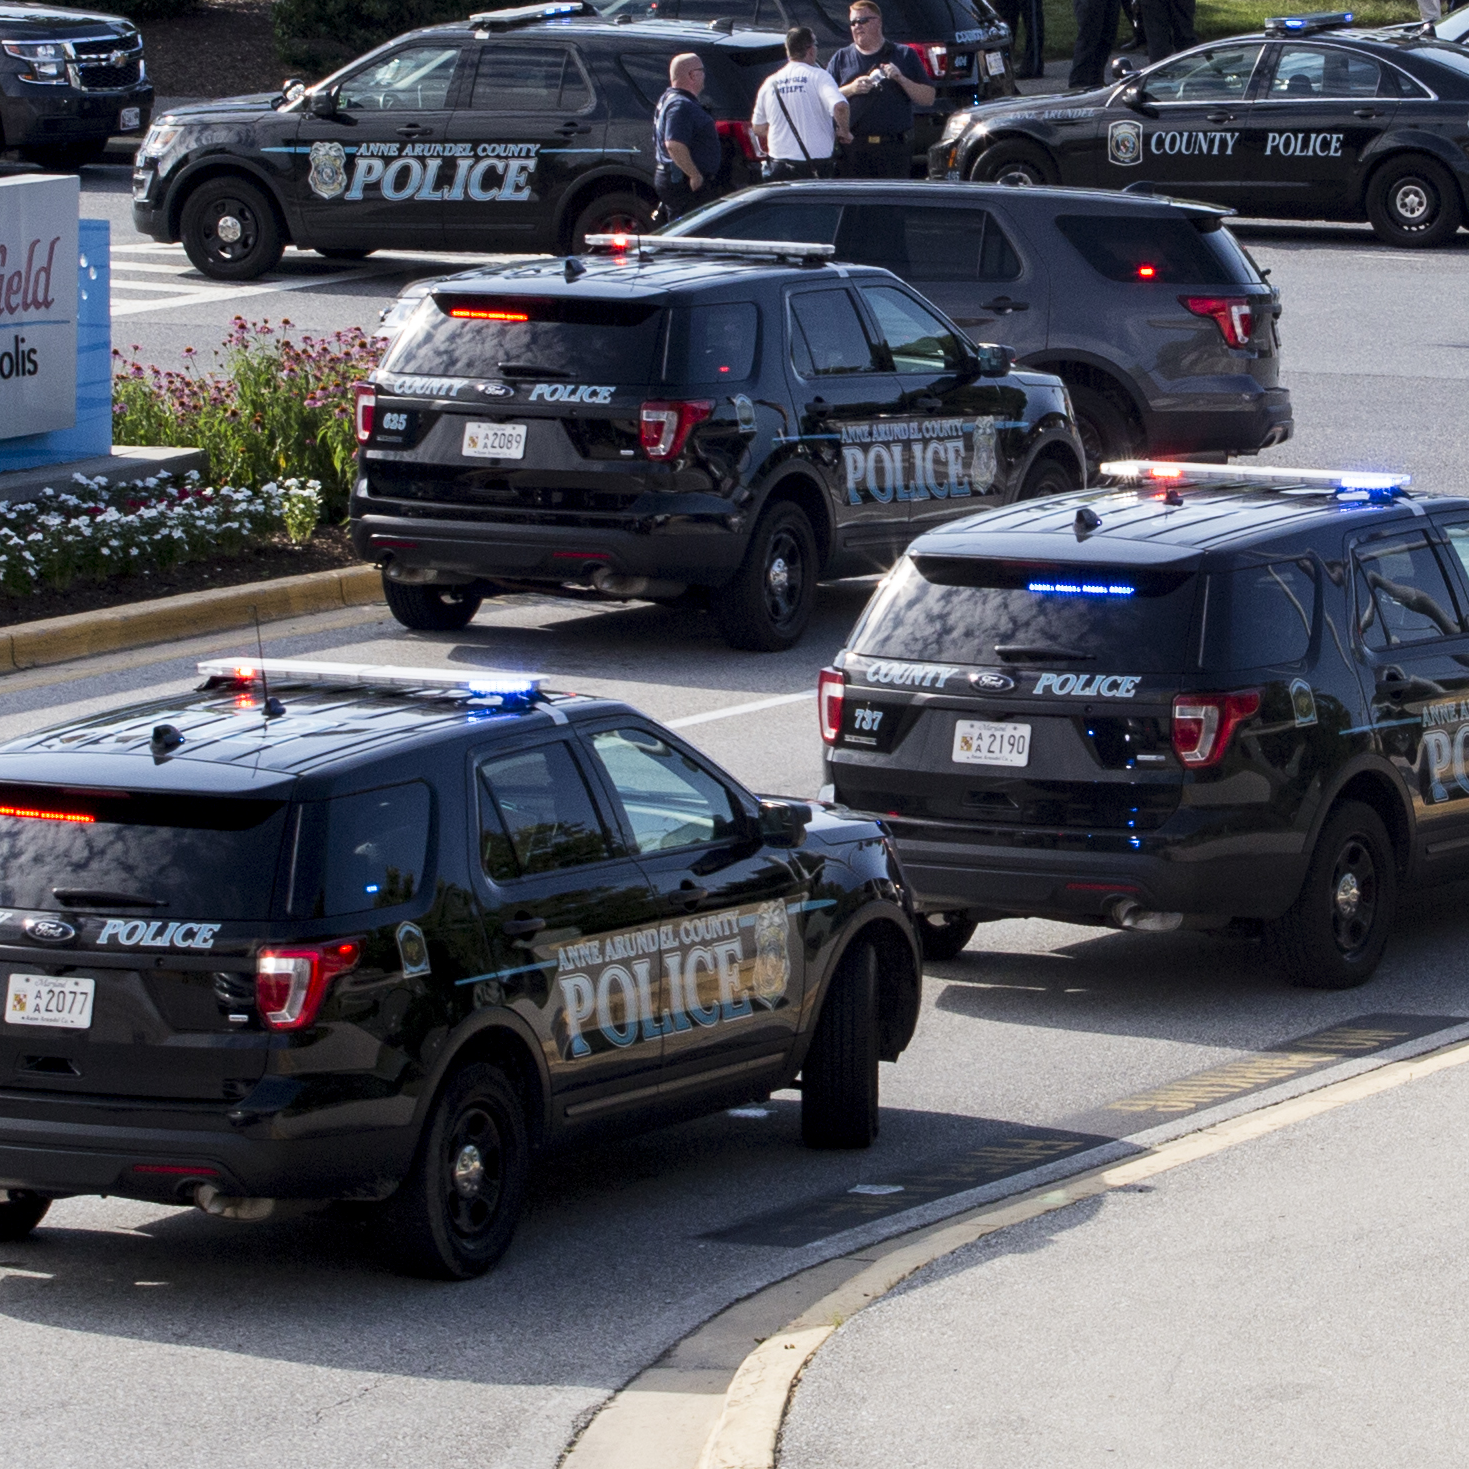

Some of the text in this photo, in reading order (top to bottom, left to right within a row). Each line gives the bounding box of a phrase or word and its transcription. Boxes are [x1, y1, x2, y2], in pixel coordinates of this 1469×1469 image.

[1041, 107, 1095, 120] ARUNDEL
[356, 142, 541, 157] ANNE ARUNDEL COUNTY
[1150, 130, 1343, 157] COUNTY POLICE
[344, 157, 538, 201] POLICE
[393, 377, 469, 397] COUNTY
[484, 385, 506, 396] Ford
[529, 383, 616, 404] POLICE
[382, 412, 407, 430] 625
[841, 418, 964, 444] ANNE ARUNDEL COUNTY
[490, 431, 522, 450] 2089
[841, 437, 972, 505] POLICE
[866, 661, 959, 688] COUNTY
[978, 674, 1005, 688] Ford
[1032, 672, 1142, 698] POLICE
[854, 708, 883, 731] 737
[1422, 701, 1459, 728] ANNE
[987, 733, 1026, 755] 2190
[35, 921, 63, 938] Ford
[96, 919, 221, 948] POLICE
[558, 910, 740, 972] ANNE ARUNDEL COUNTY
[34, 978, 67, 989] Maryland
[44, 988, 90, 1016] 2077
[559, 936, 753, 1058] POLICE
